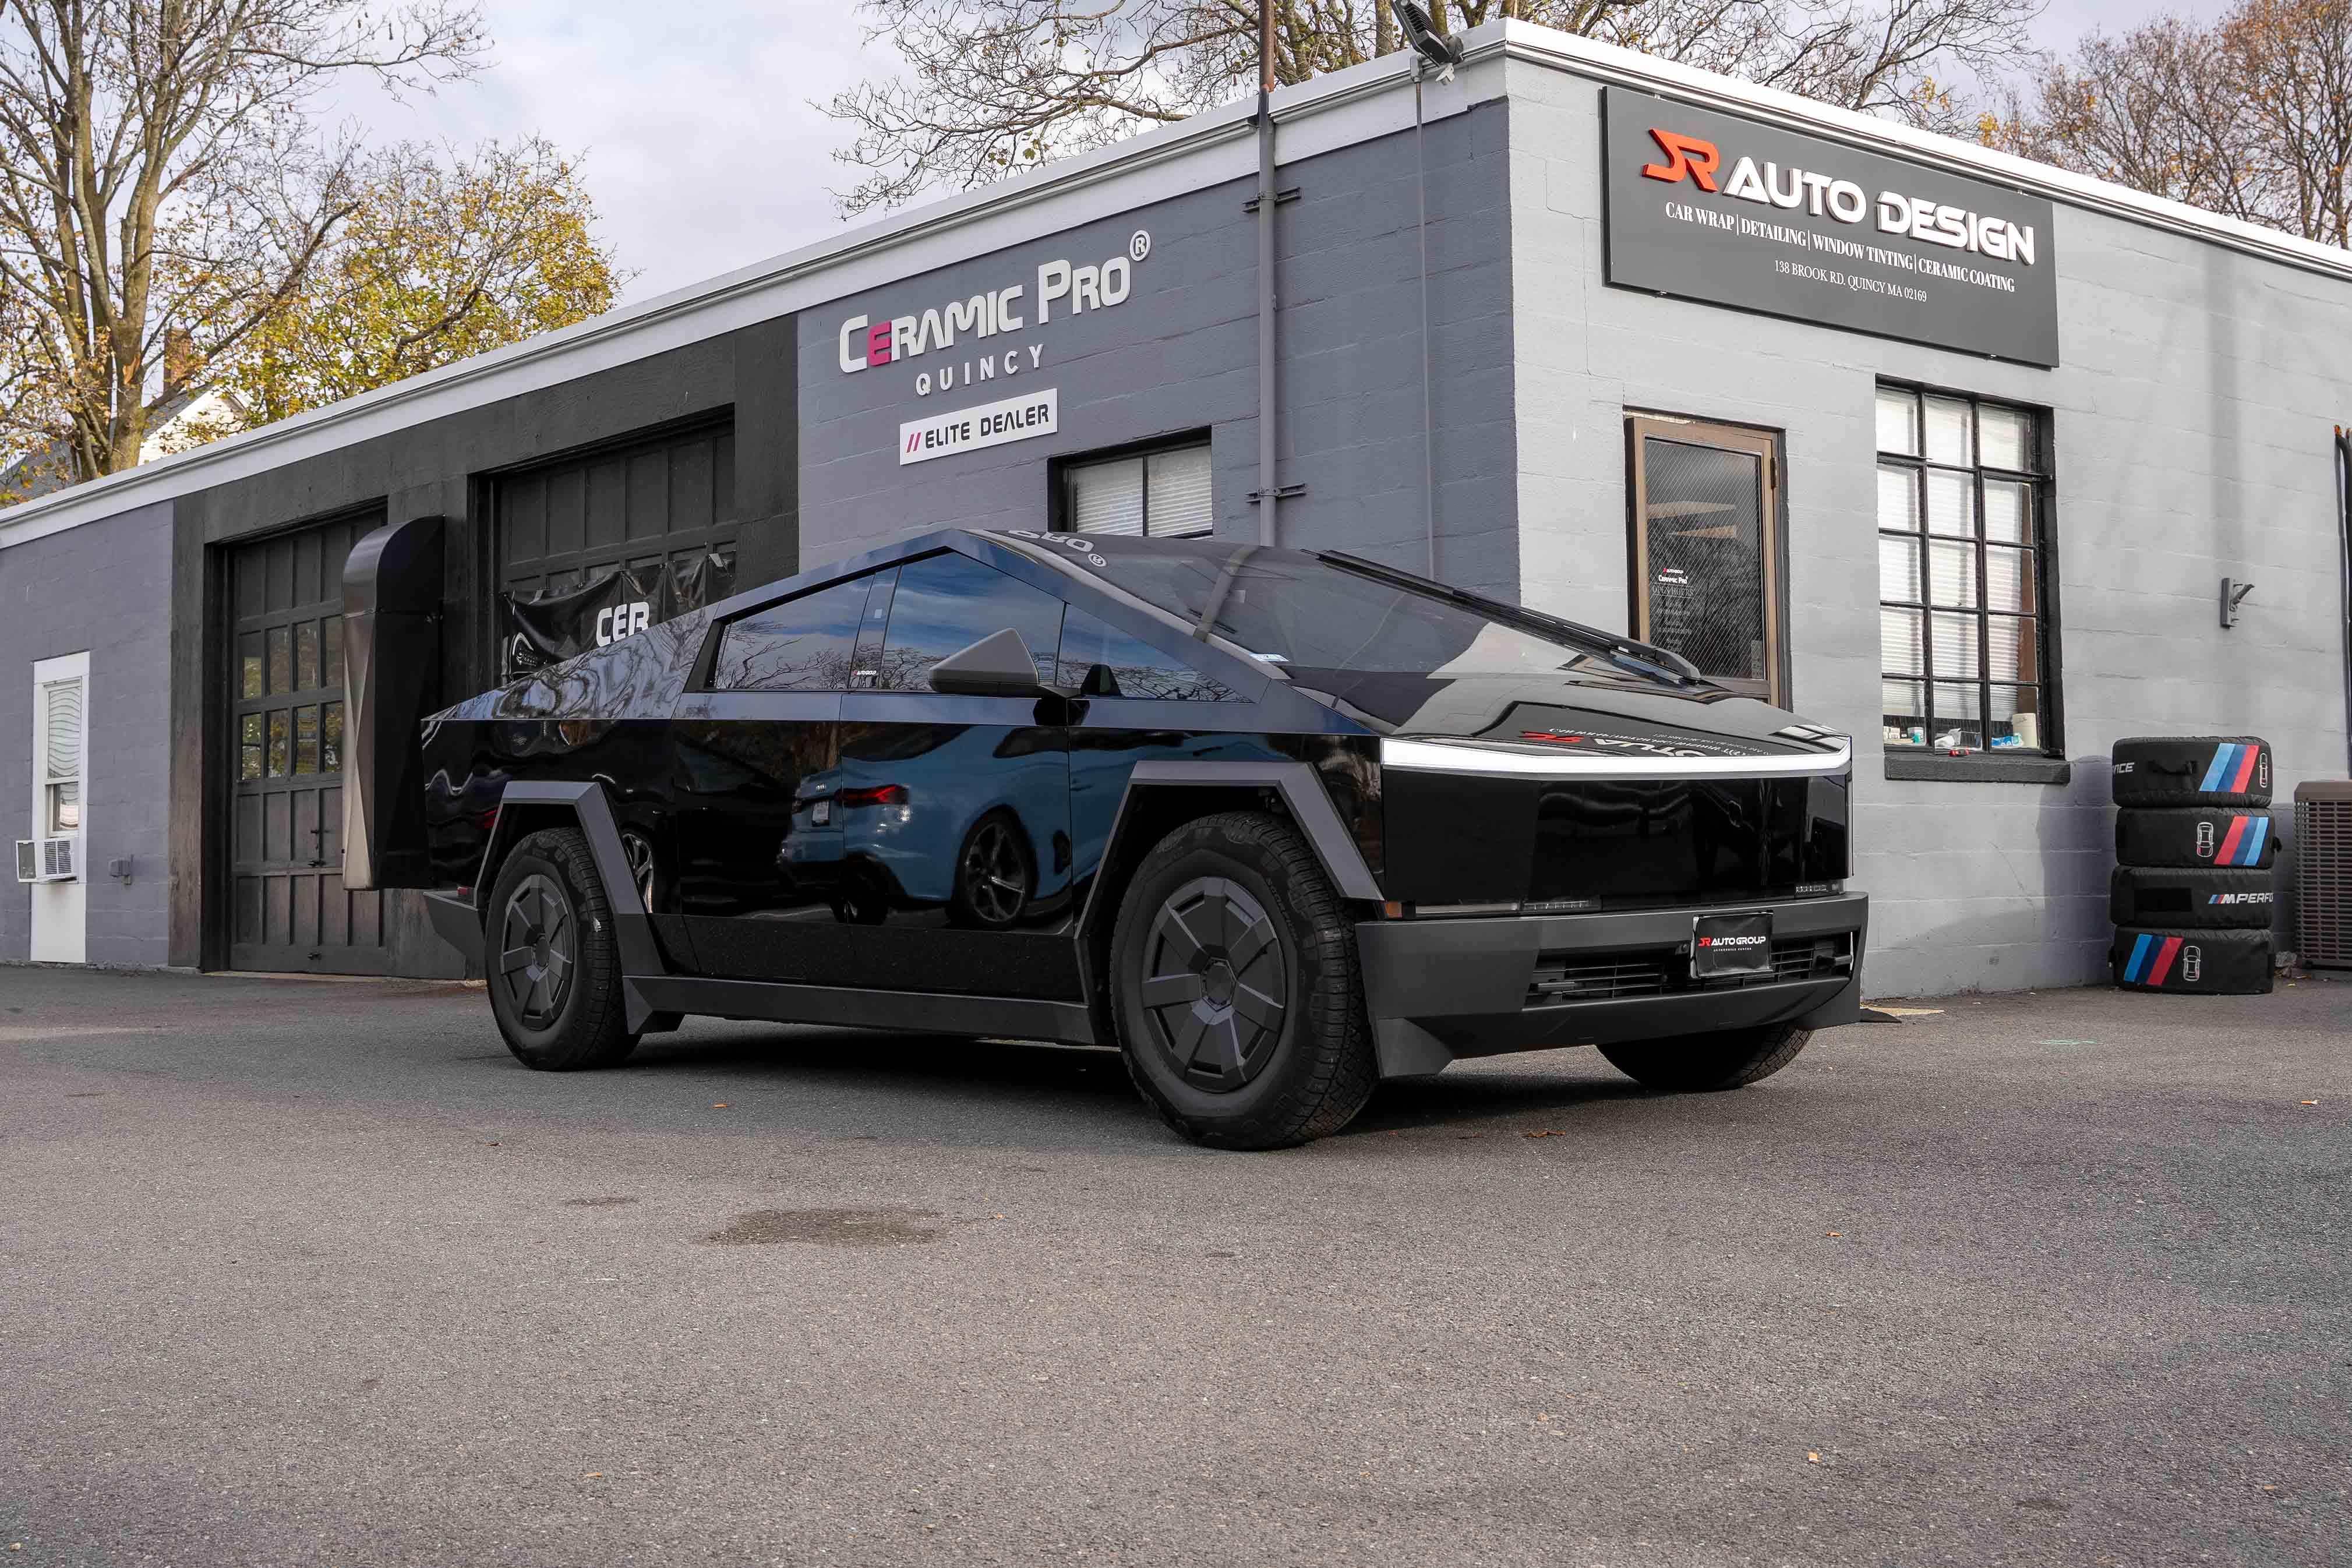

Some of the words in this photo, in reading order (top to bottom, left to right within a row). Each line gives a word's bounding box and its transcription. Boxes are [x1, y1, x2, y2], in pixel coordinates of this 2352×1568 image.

[1722, 156, 1866, 224] AUTO
[1876, 190, 2035, 265] DESIGN
[1665, 202, 1694, 222] CAR
[1812, 233, 1864, 260] WINDOW
[1866, 246, 1913, 270] TINTING
[1918, 257, 1969, 282] CERAMIC
[1969, 269, 2015, 292] COATING
[1775, 260, 1790, 274] 138
[1791, 263, 1828, 282] BROOK
[1830, 271, 1846, 285] RD.
[1848, 275, 1887, 293] QUINCY
[1887, 284, 1904, 297] MA
[1904, 287, 1927, 302] 02169
[839, 285, 1023, 373] CERAMIC
[916, 344, 1045, 396] QUINCY
[925, 420, 971, 449] ELITE
[979, 403, 1050, 437] DEALER
